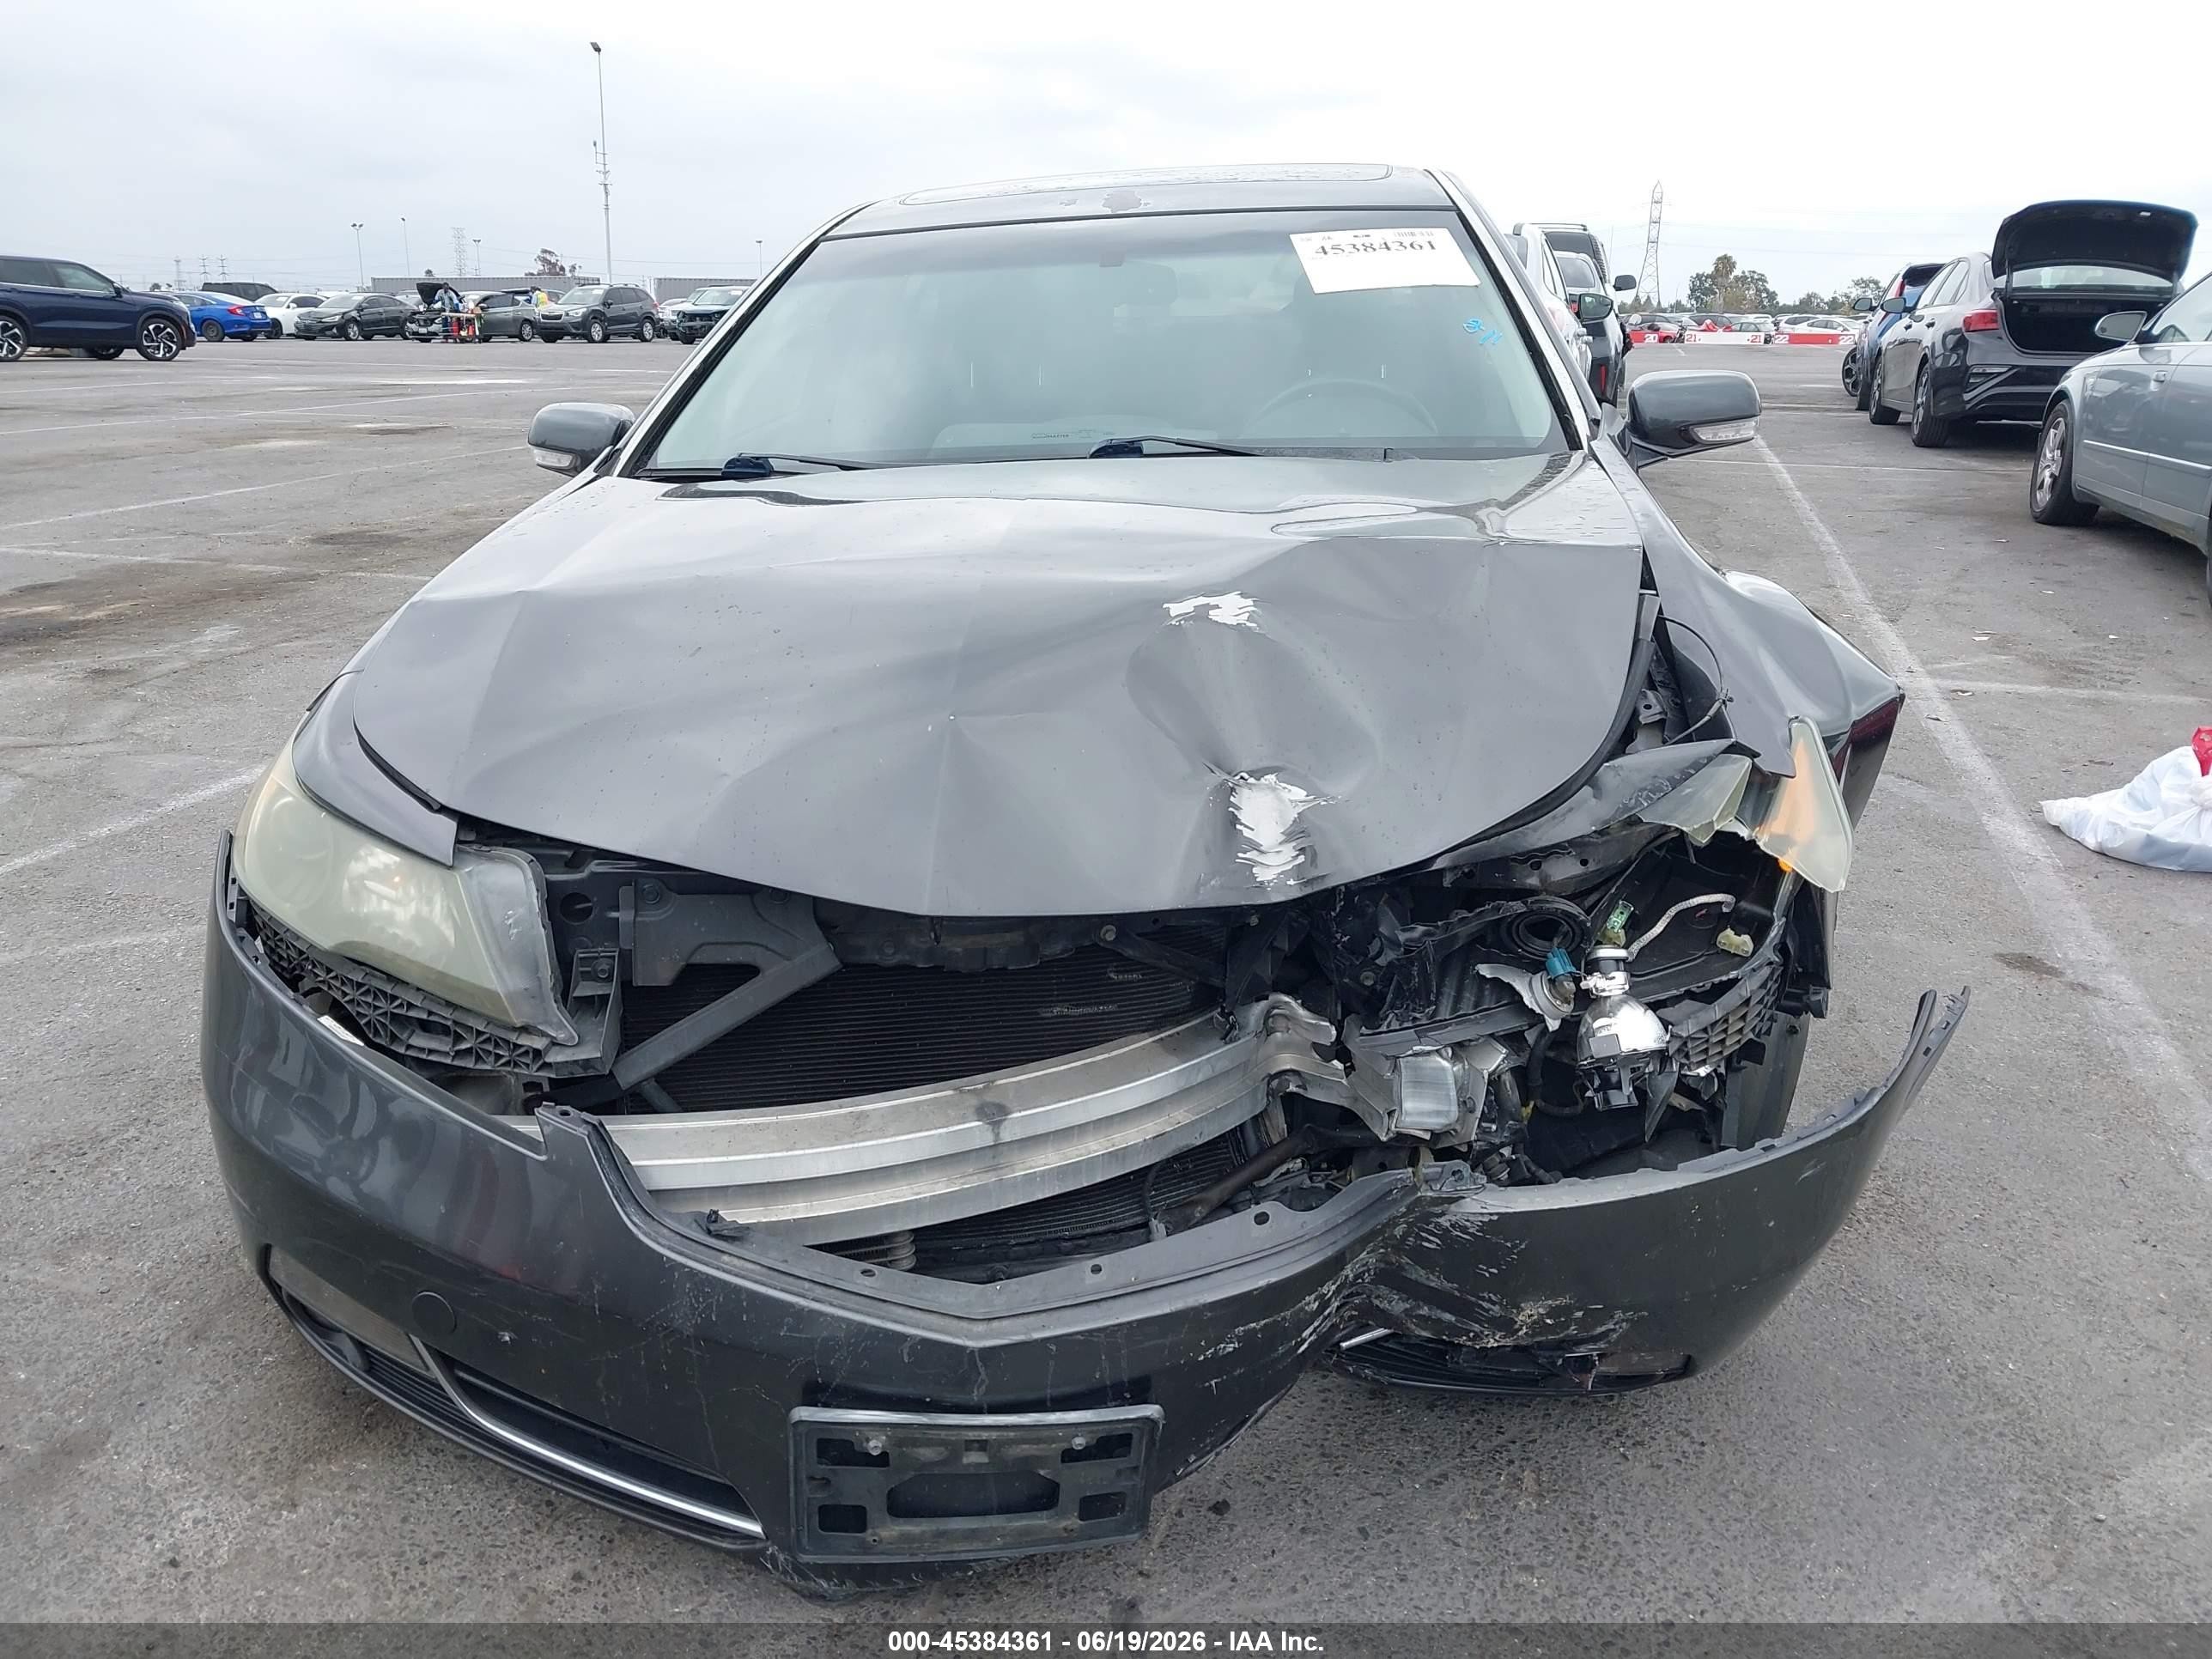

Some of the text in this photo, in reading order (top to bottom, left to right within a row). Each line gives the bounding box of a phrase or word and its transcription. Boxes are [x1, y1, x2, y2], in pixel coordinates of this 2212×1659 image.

[1315, 240, 1437, 256] 45384361
[1686, 333, 1697, 343] 21
[1750, 334, 1762, 343] 21
[1774, 334, 1789, 343] 22
[1838, 335, 1854, 344] 22
